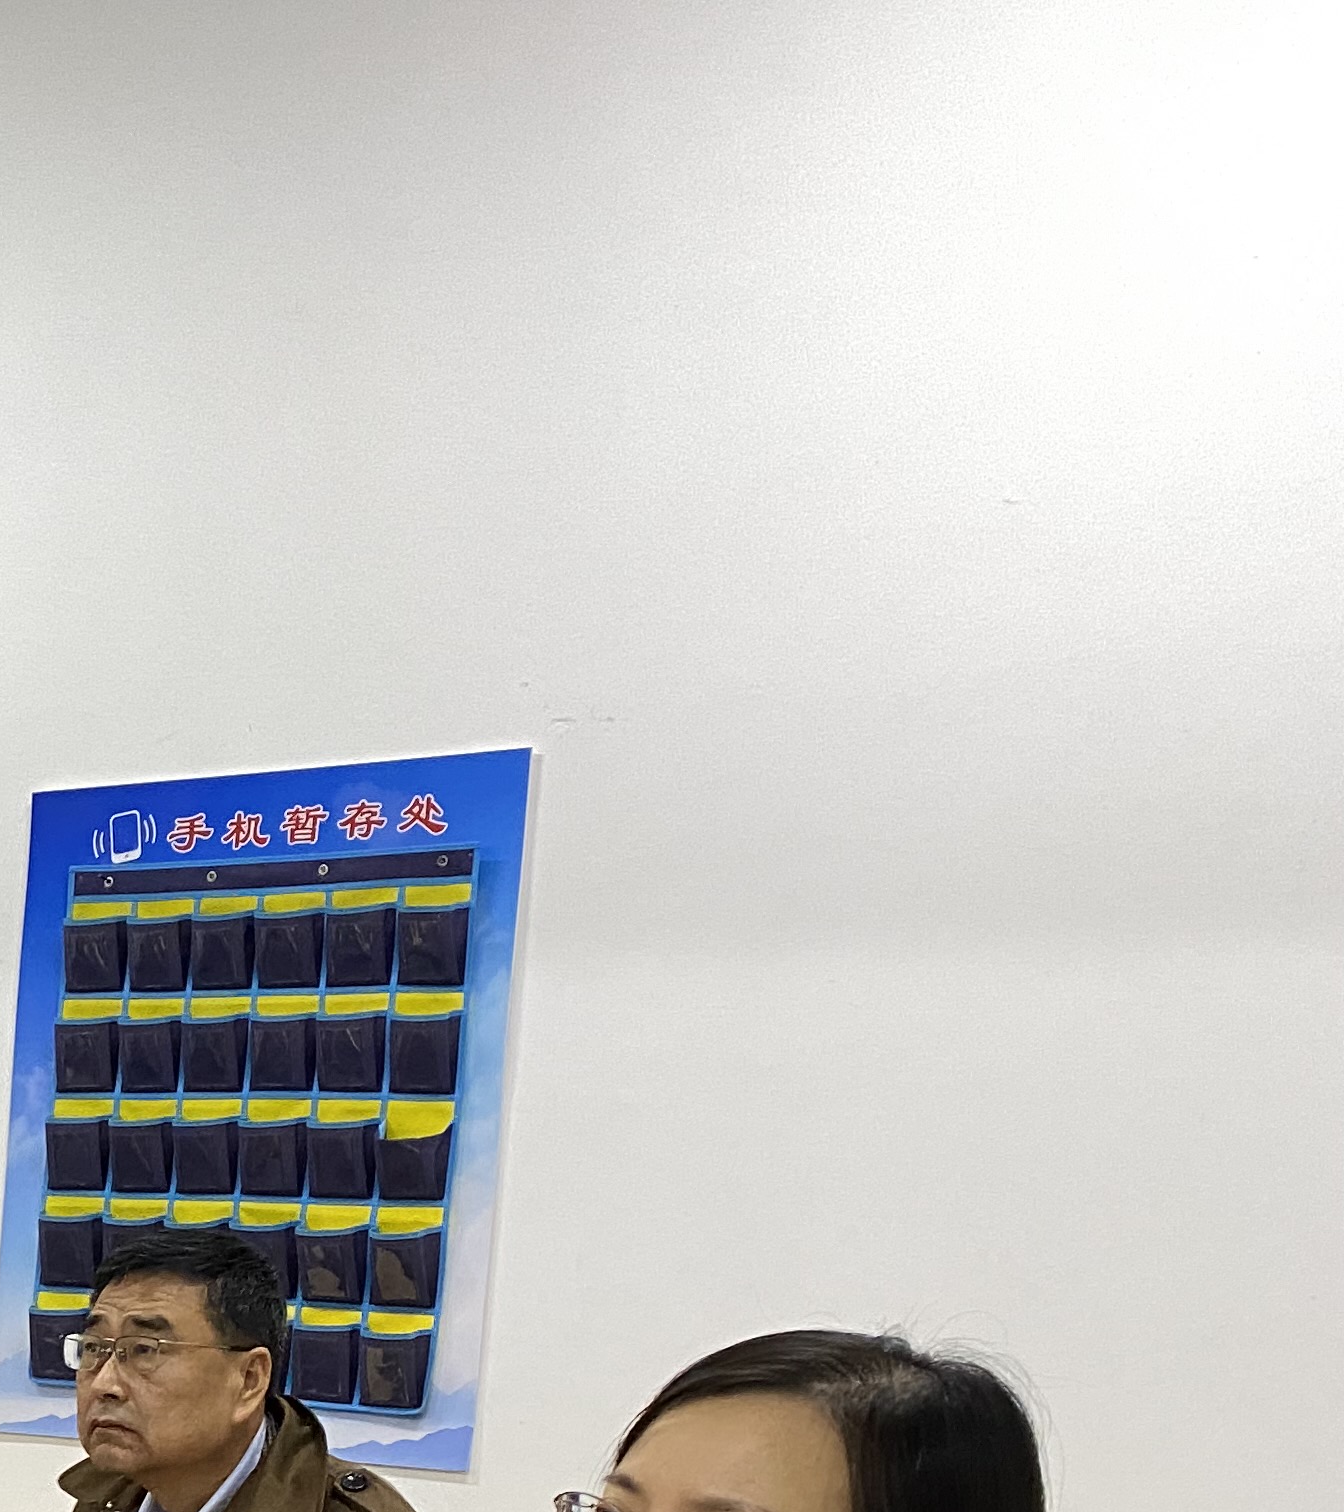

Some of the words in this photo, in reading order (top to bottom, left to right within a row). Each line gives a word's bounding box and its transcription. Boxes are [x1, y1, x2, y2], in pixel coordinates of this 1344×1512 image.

[167, 793, 449, 854] 手机暂存处
